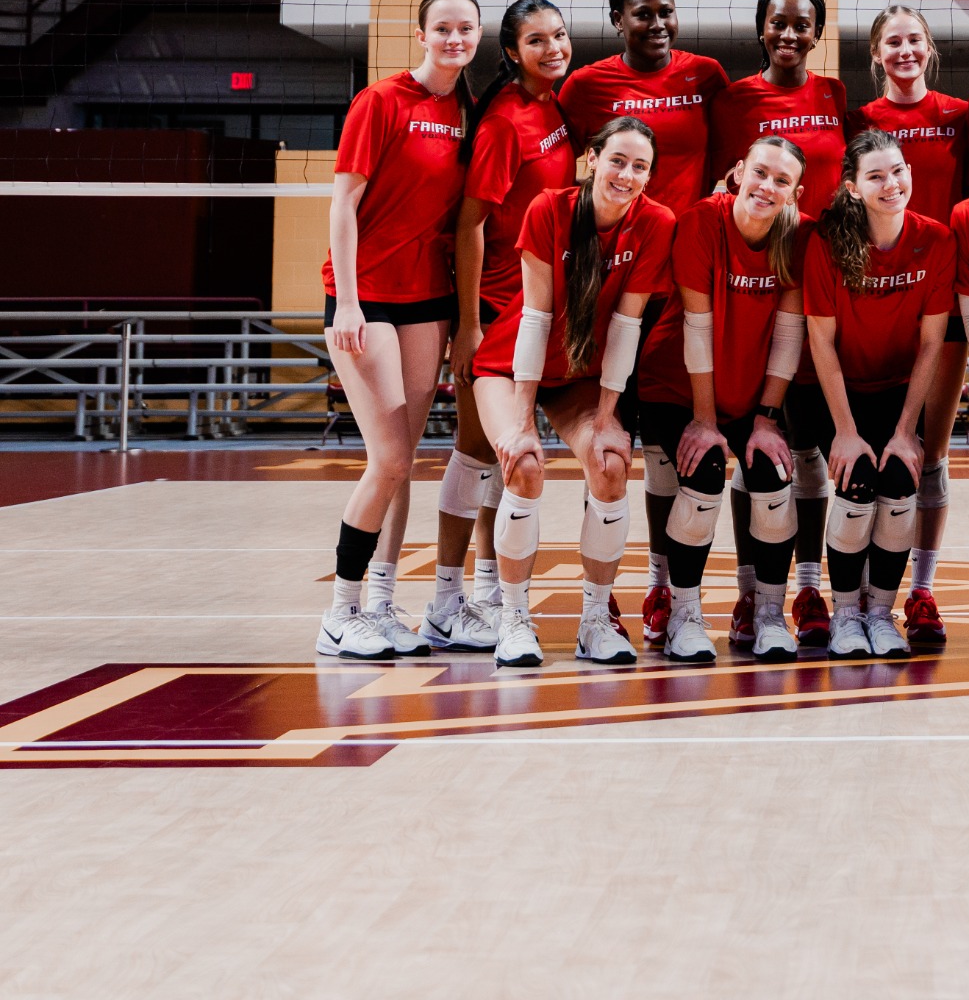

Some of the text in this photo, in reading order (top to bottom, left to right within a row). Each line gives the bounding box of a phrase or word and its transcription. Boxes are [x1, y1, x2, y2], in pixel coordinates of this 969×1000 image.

[612, 94, 703, 112] FAIRFIELD
[409, 121, 463, 138] FAIRFIE
[759, 115, 839, 133] FAIRFIELD
[539, 124, 568, 154] FAIRFIE
[888, 127, 955, 140] IRFIELD
